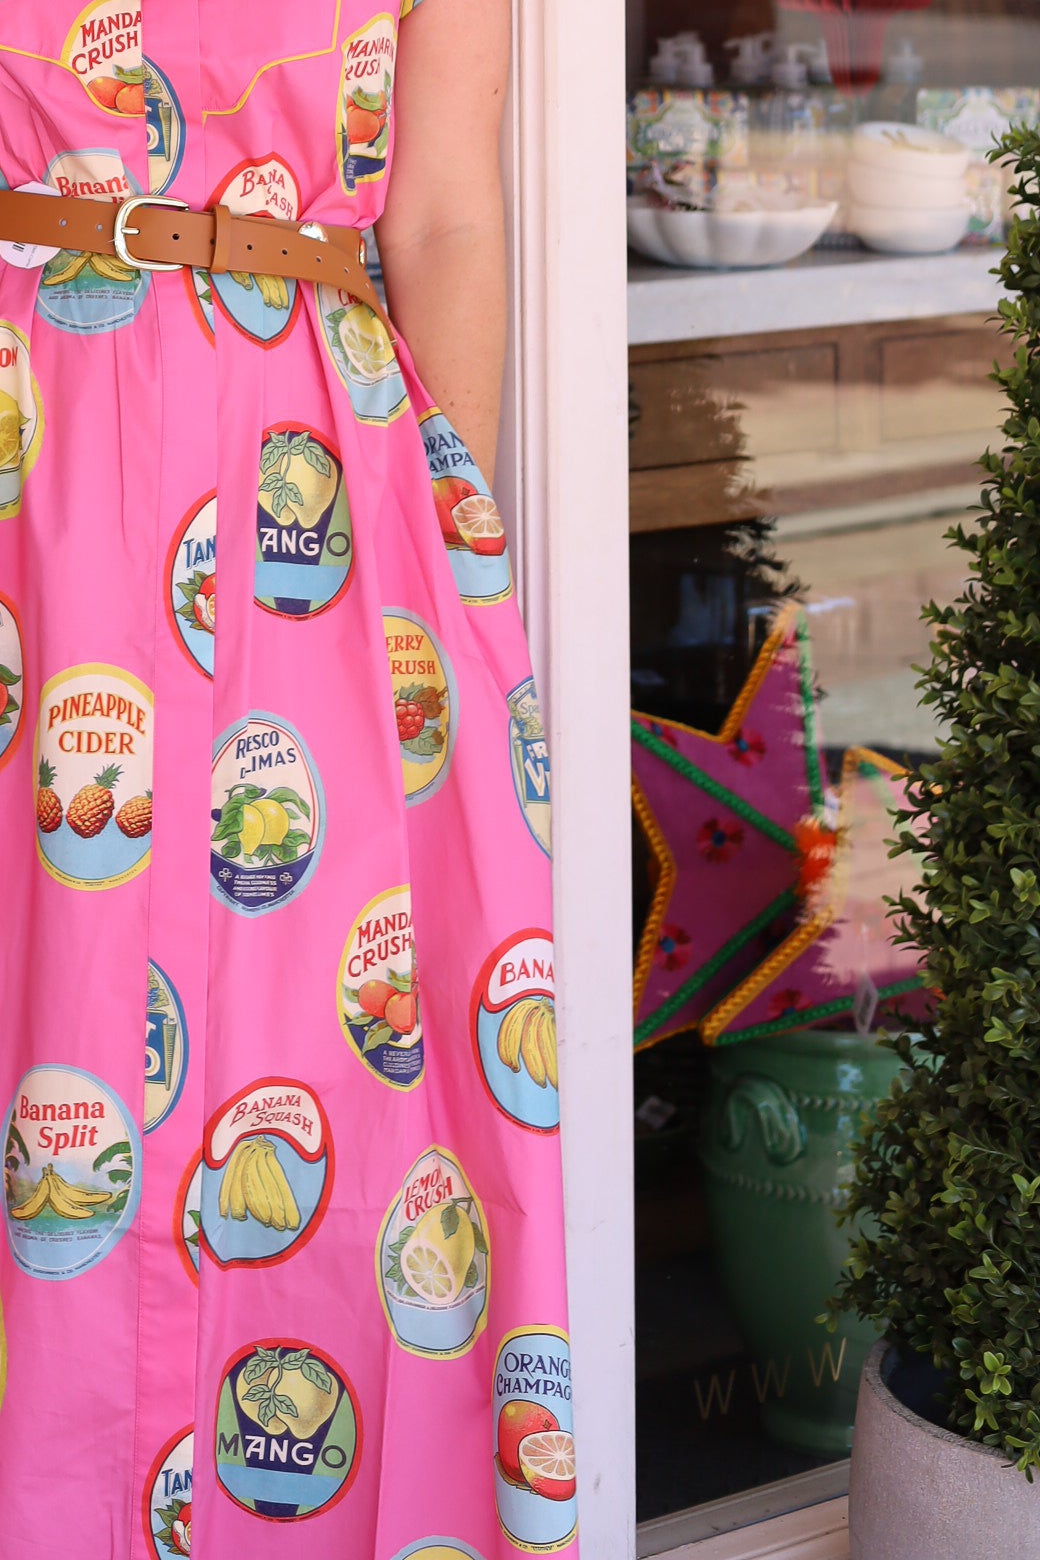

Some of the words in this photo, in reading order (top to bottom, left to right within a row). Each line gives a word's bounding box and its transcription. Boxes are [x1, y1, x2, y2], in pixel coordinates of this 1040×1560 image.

[71, 30, 139, 75] CRUSH
[47, 691, 147, 736] PINEAPPLE
[58, 730, 136, 756] CIDER
[235, 730, 280, 760] RESCO
[347, 931, 413, 978] CRUSH
[19, 1094, 105, 1123] Banana
[230, 1093, 303, 1128] BANANA
[249, 1109, 314, 1137] SQUASH
[36, 1124, 99, 1156] Split
[405, 1176, 454, 1222] CRUSH
[217, 1430, 348, 1470] MANGO
